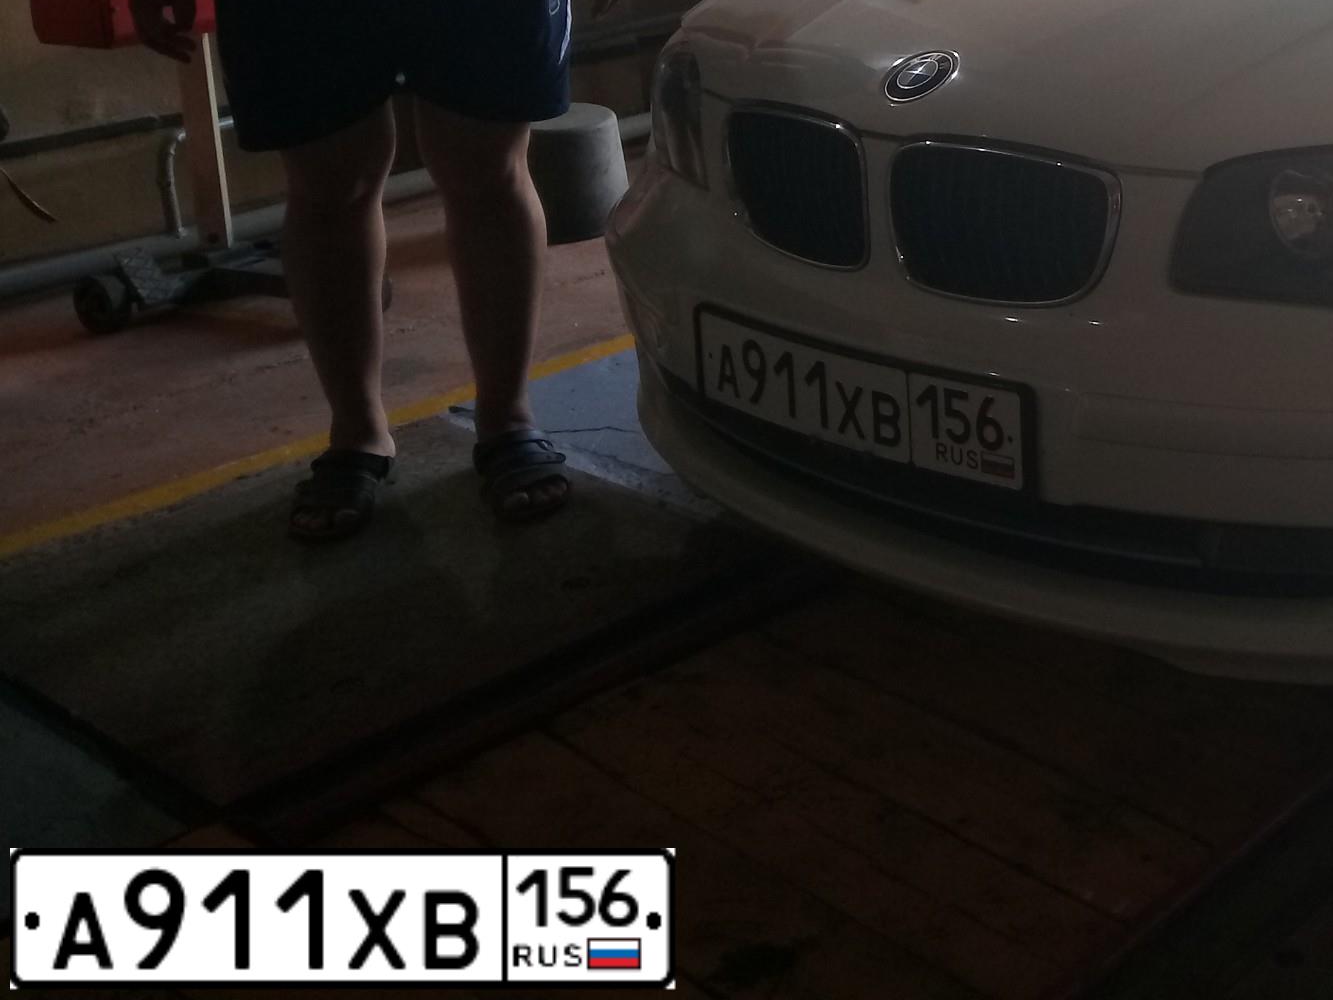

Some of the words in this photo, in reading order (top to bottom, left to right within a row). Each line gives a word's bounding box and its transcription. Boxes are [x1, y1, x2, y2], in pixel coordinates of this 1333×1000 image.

[718, 339, 901, 448] А911ХВ
[916, 384, 1004, 451] 156
[935, 443, 979, 470] RUS
